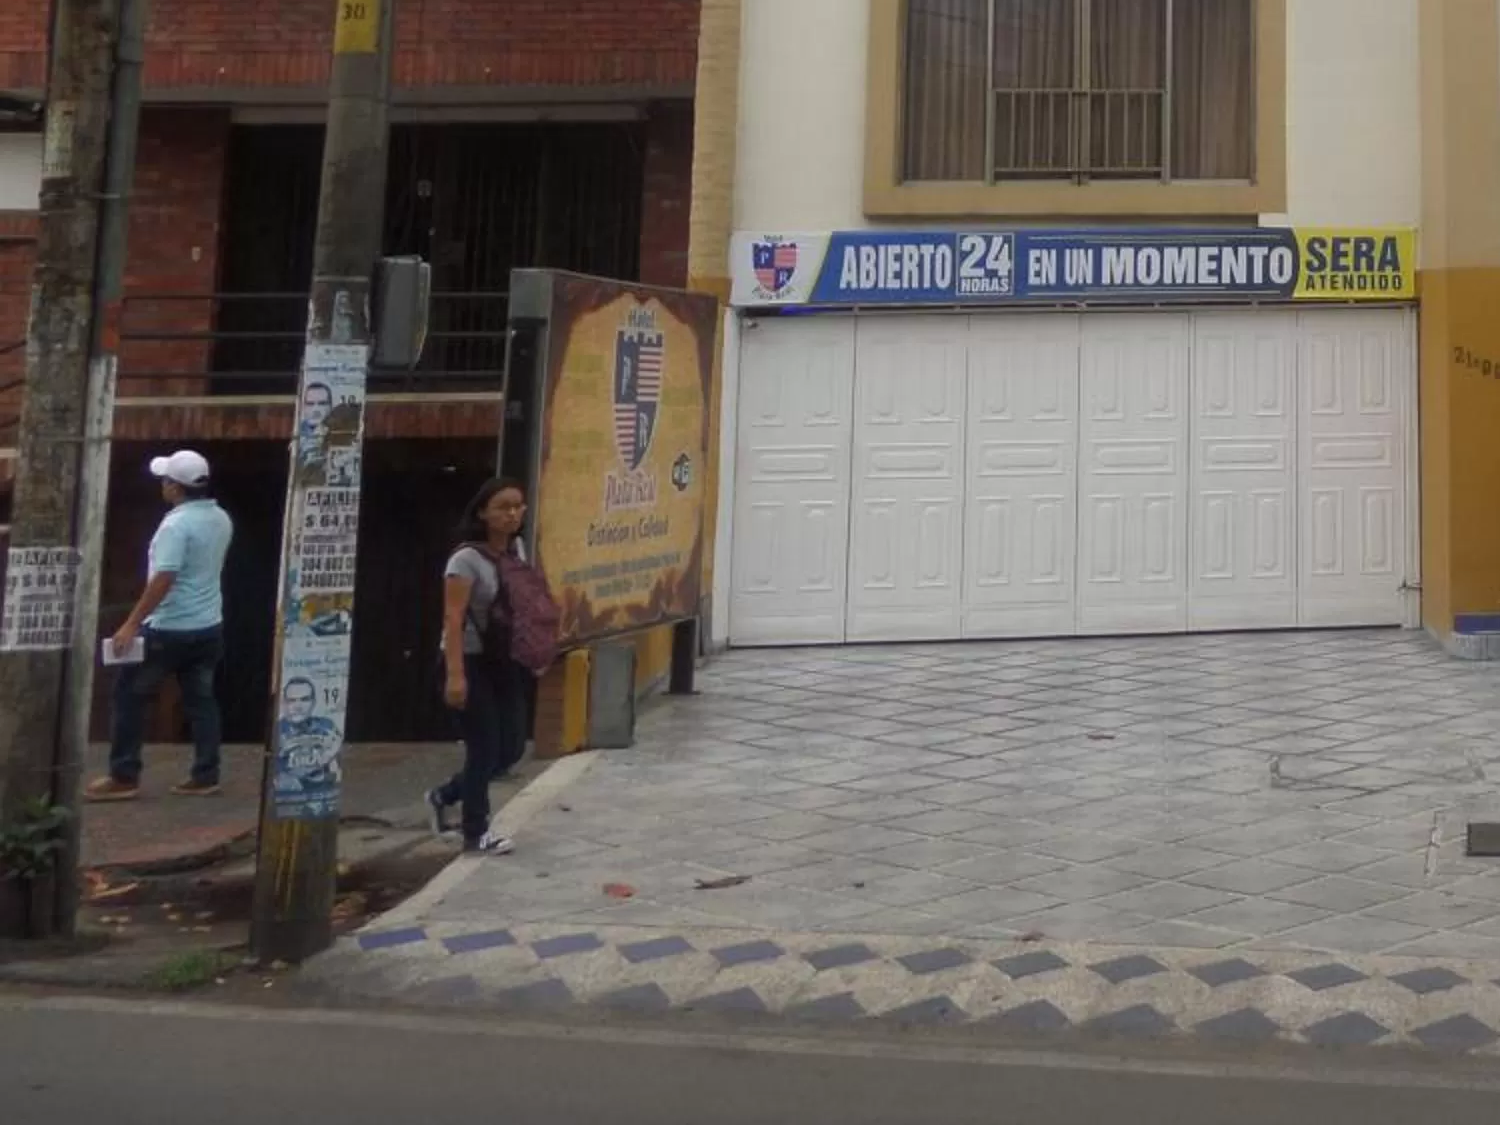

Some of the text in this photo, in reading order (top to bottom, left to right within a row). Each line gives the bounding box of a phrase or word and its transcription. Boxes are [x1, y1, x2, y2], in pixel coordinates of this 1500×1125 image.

[839, 234, 1011, 291] ABIERTO 24
[1027, 245, 1294, 286] EN UN MOMENTO
[1305, 235, 1402, 273] SERA
[960, 277, 1009, 293] HORAS
[1305, 273, 1403, 291] ATENDIDO
